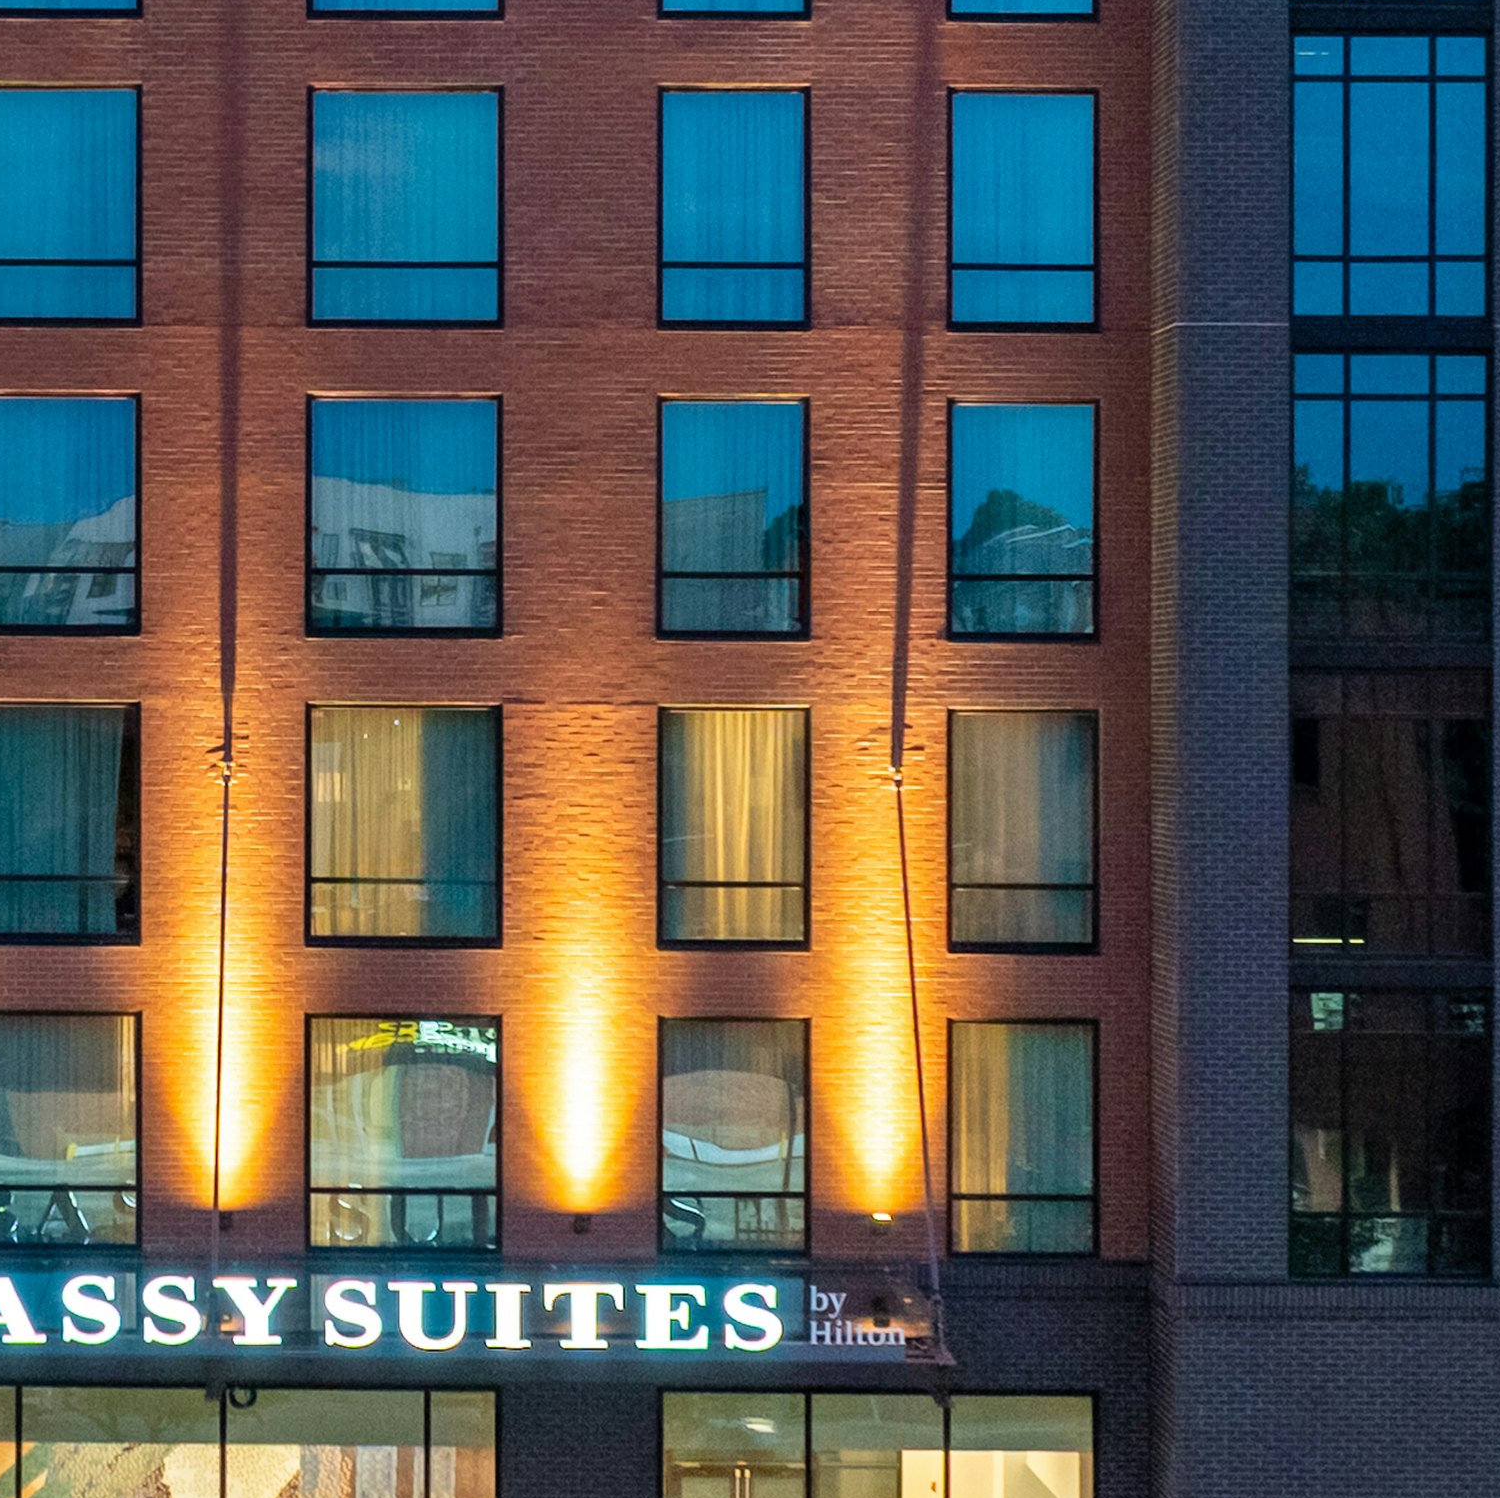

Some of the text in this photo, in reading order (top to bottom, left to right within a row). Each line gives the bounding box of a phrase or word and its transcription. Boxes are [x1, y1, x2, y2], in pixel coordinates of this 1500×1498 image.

[322, 1279, 785, 1352] SUITES
[810, 1285, 847, 1319] by
[809, 1320, 907, 1346] Hilton
